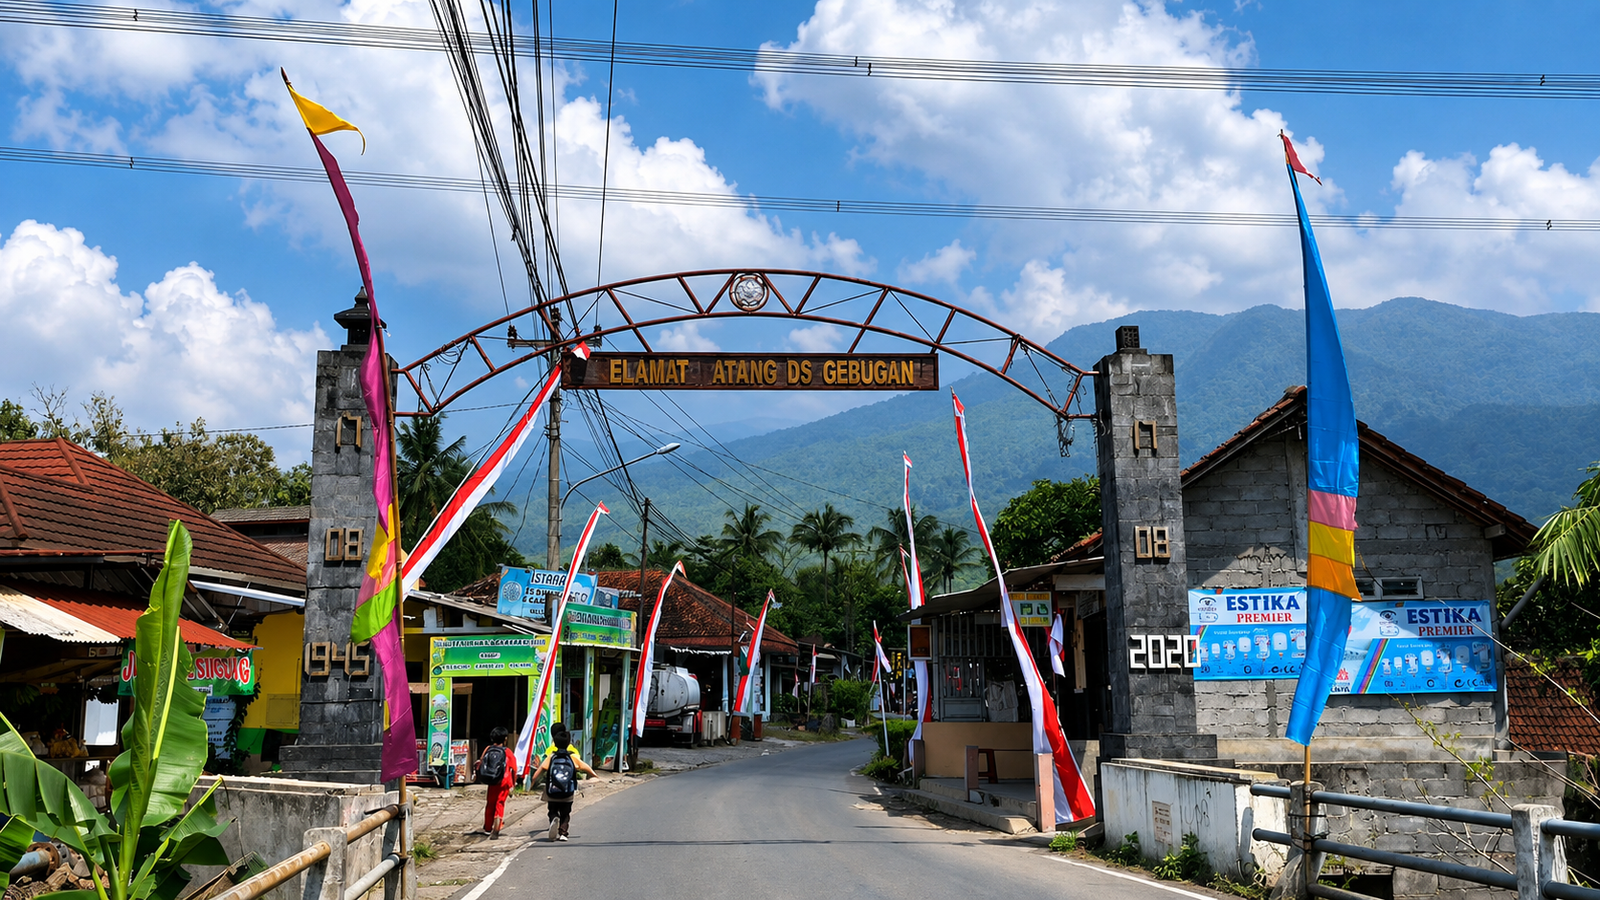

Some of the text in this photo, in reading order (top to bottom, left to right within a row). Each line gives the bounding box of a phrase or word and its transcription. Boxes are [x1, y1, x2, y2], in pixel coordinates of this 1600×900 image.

[609, 359, 914, 384] ELAMAT ATANG DS GEBUGAN
[325, 528, 363, 561] 08
[1134, 526, 1170, 559] 08
[1226, 596, 1300, 611] ESTIKA
[1407, 608, 1482, 624] ESTIKA
[1237, 613, 1292, 623] PREMIER
[1418, 626, 1474, 636] PREMIER
[304, 641, 370, 676] 1945
[1130, 634, 1202, 669] 2020
